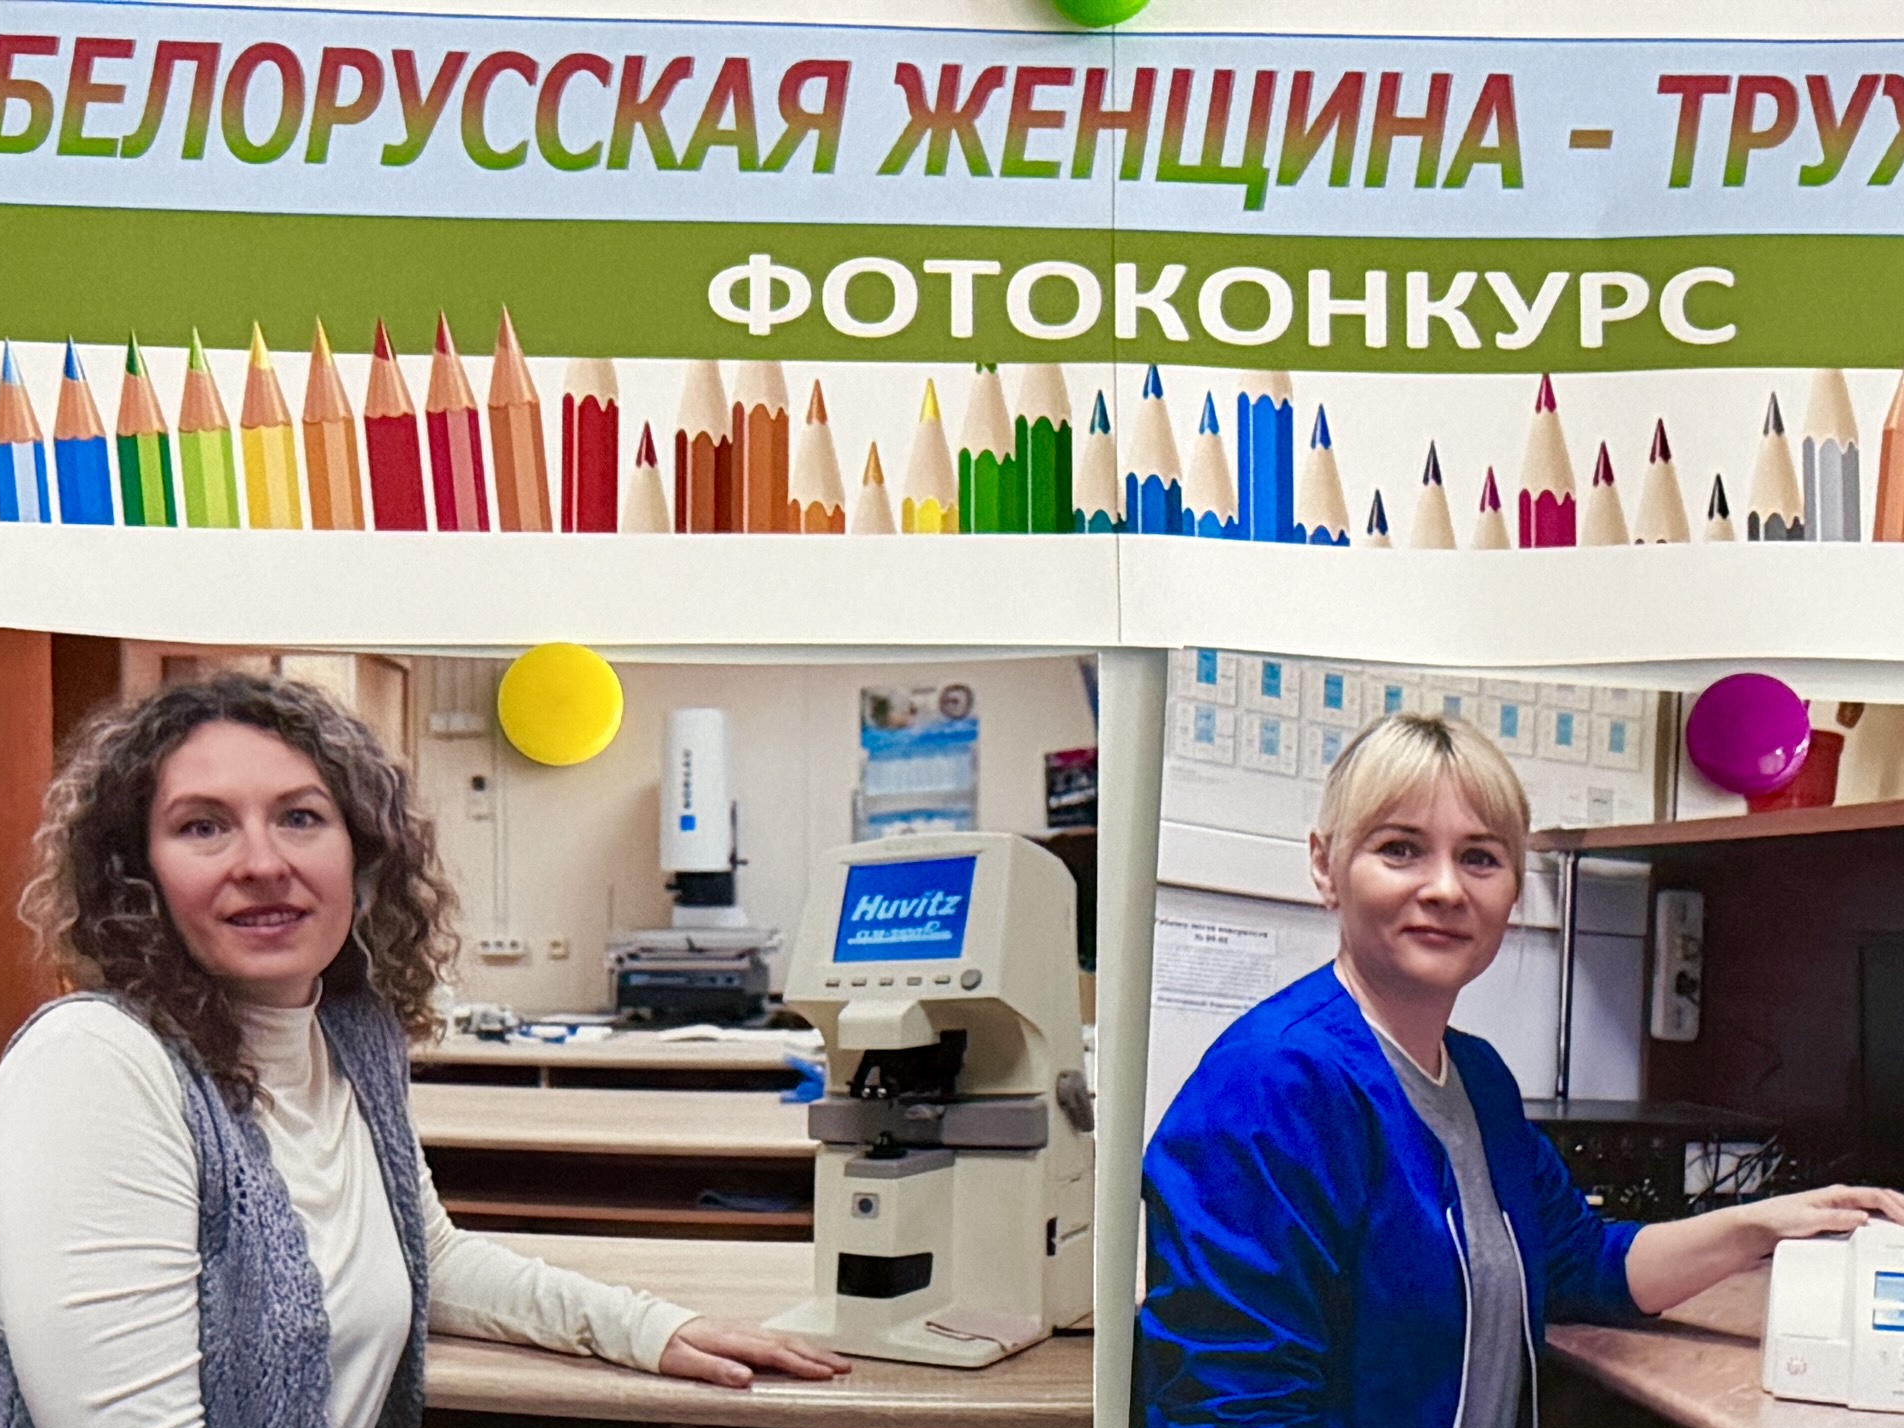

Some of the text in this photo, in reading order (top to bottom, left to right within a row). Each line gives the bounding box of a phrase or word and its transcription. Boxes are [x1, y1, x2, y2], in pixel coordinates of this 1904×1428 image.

[878, 58, 1526, 212] ЖЕНЩИНА
[706, 252, 1738, 350] ФОТОКОНКУРС
[851, 890, 963, 921] Huvitz
